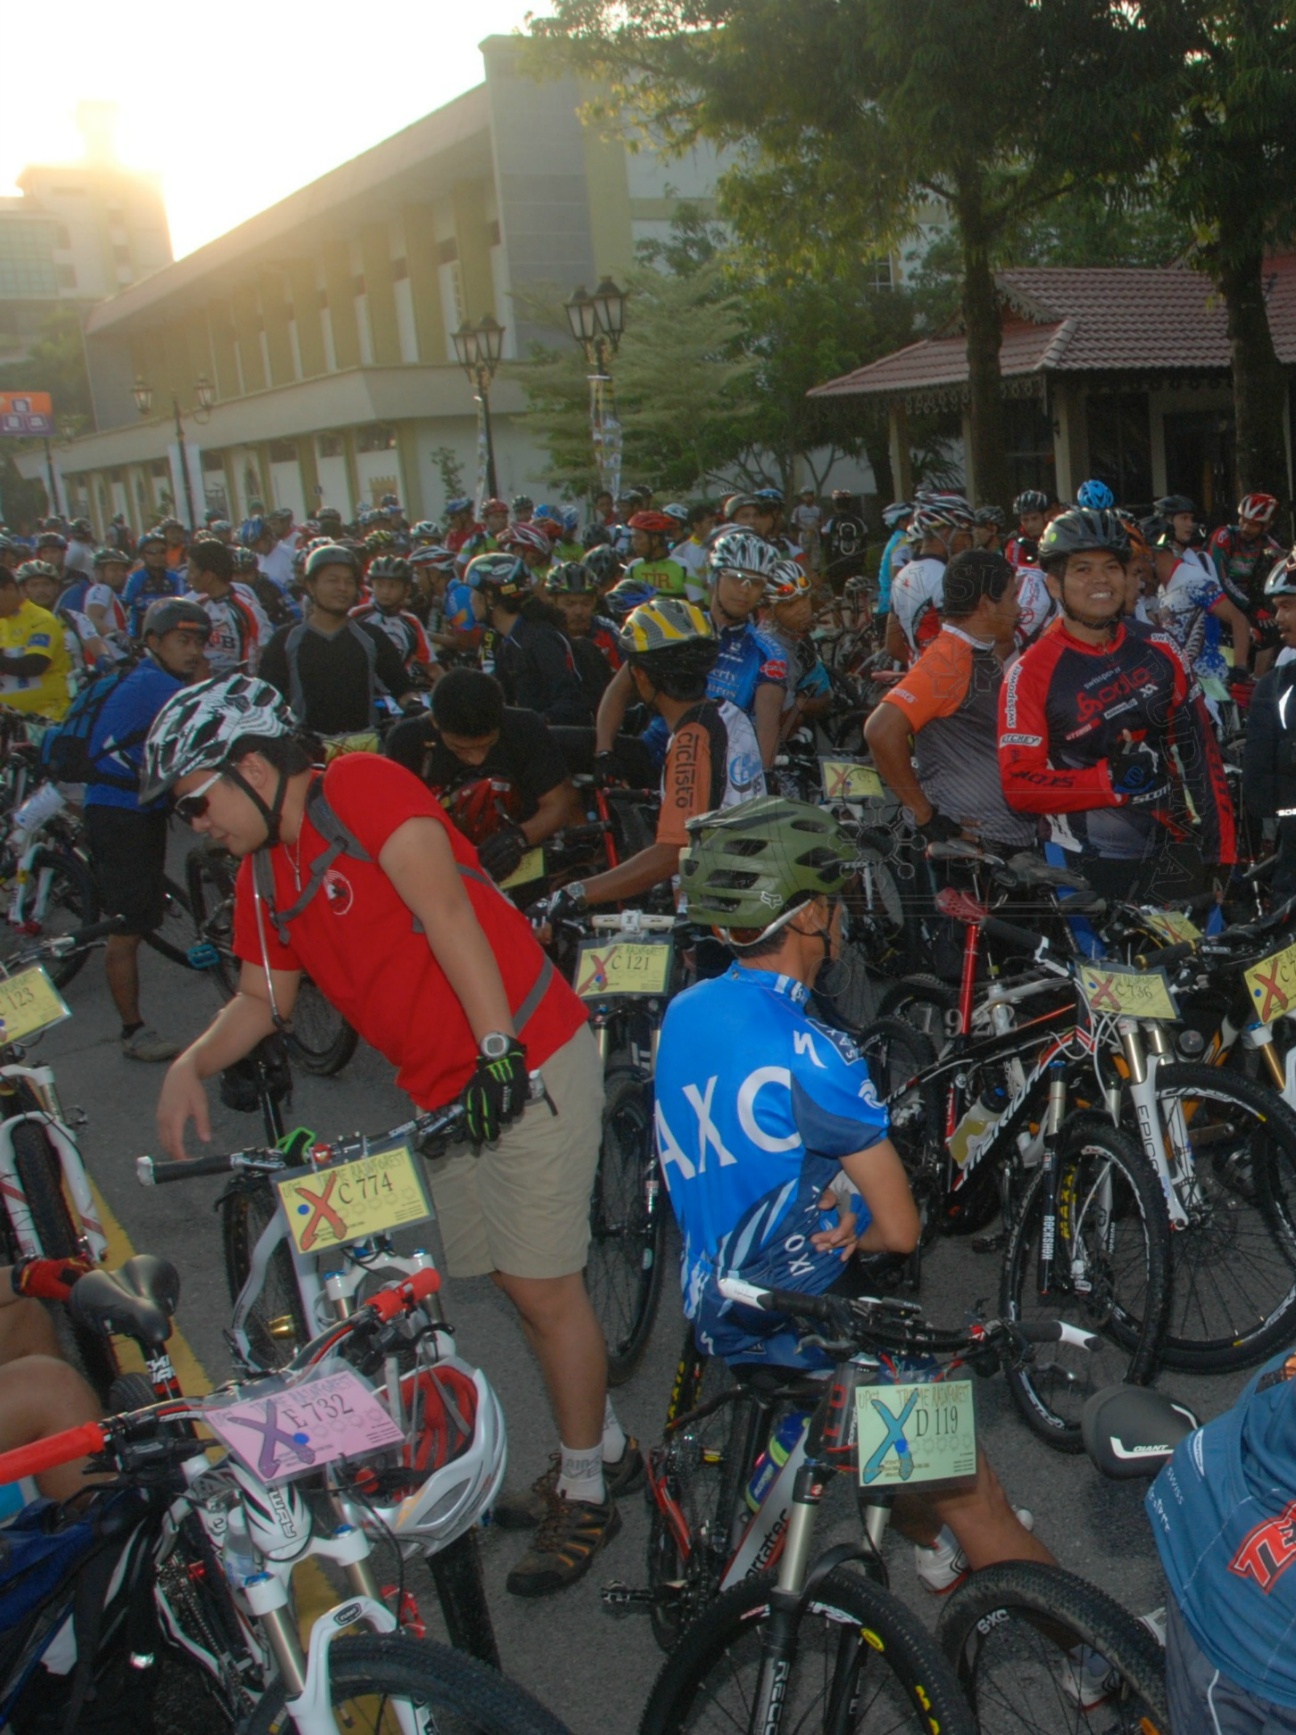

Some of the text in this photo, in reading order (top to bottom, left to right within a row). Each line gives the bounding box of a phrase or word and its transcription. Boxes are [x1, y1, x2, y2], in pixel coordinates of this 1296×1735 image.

[1007, 664, 1021, 729] swisspower
[626, 955, 650, 971] 121
[338, 1171, 393, 1205] C 774
[281, 1392, 355, 1430] E 732
[915, 1405, 959, 1438] D 119
[1133, 1444, 1169, 1453] GIANT
[1165, 1465, 1185, 1506] SWISS
[743, 1507, 790, 1580] orratec
